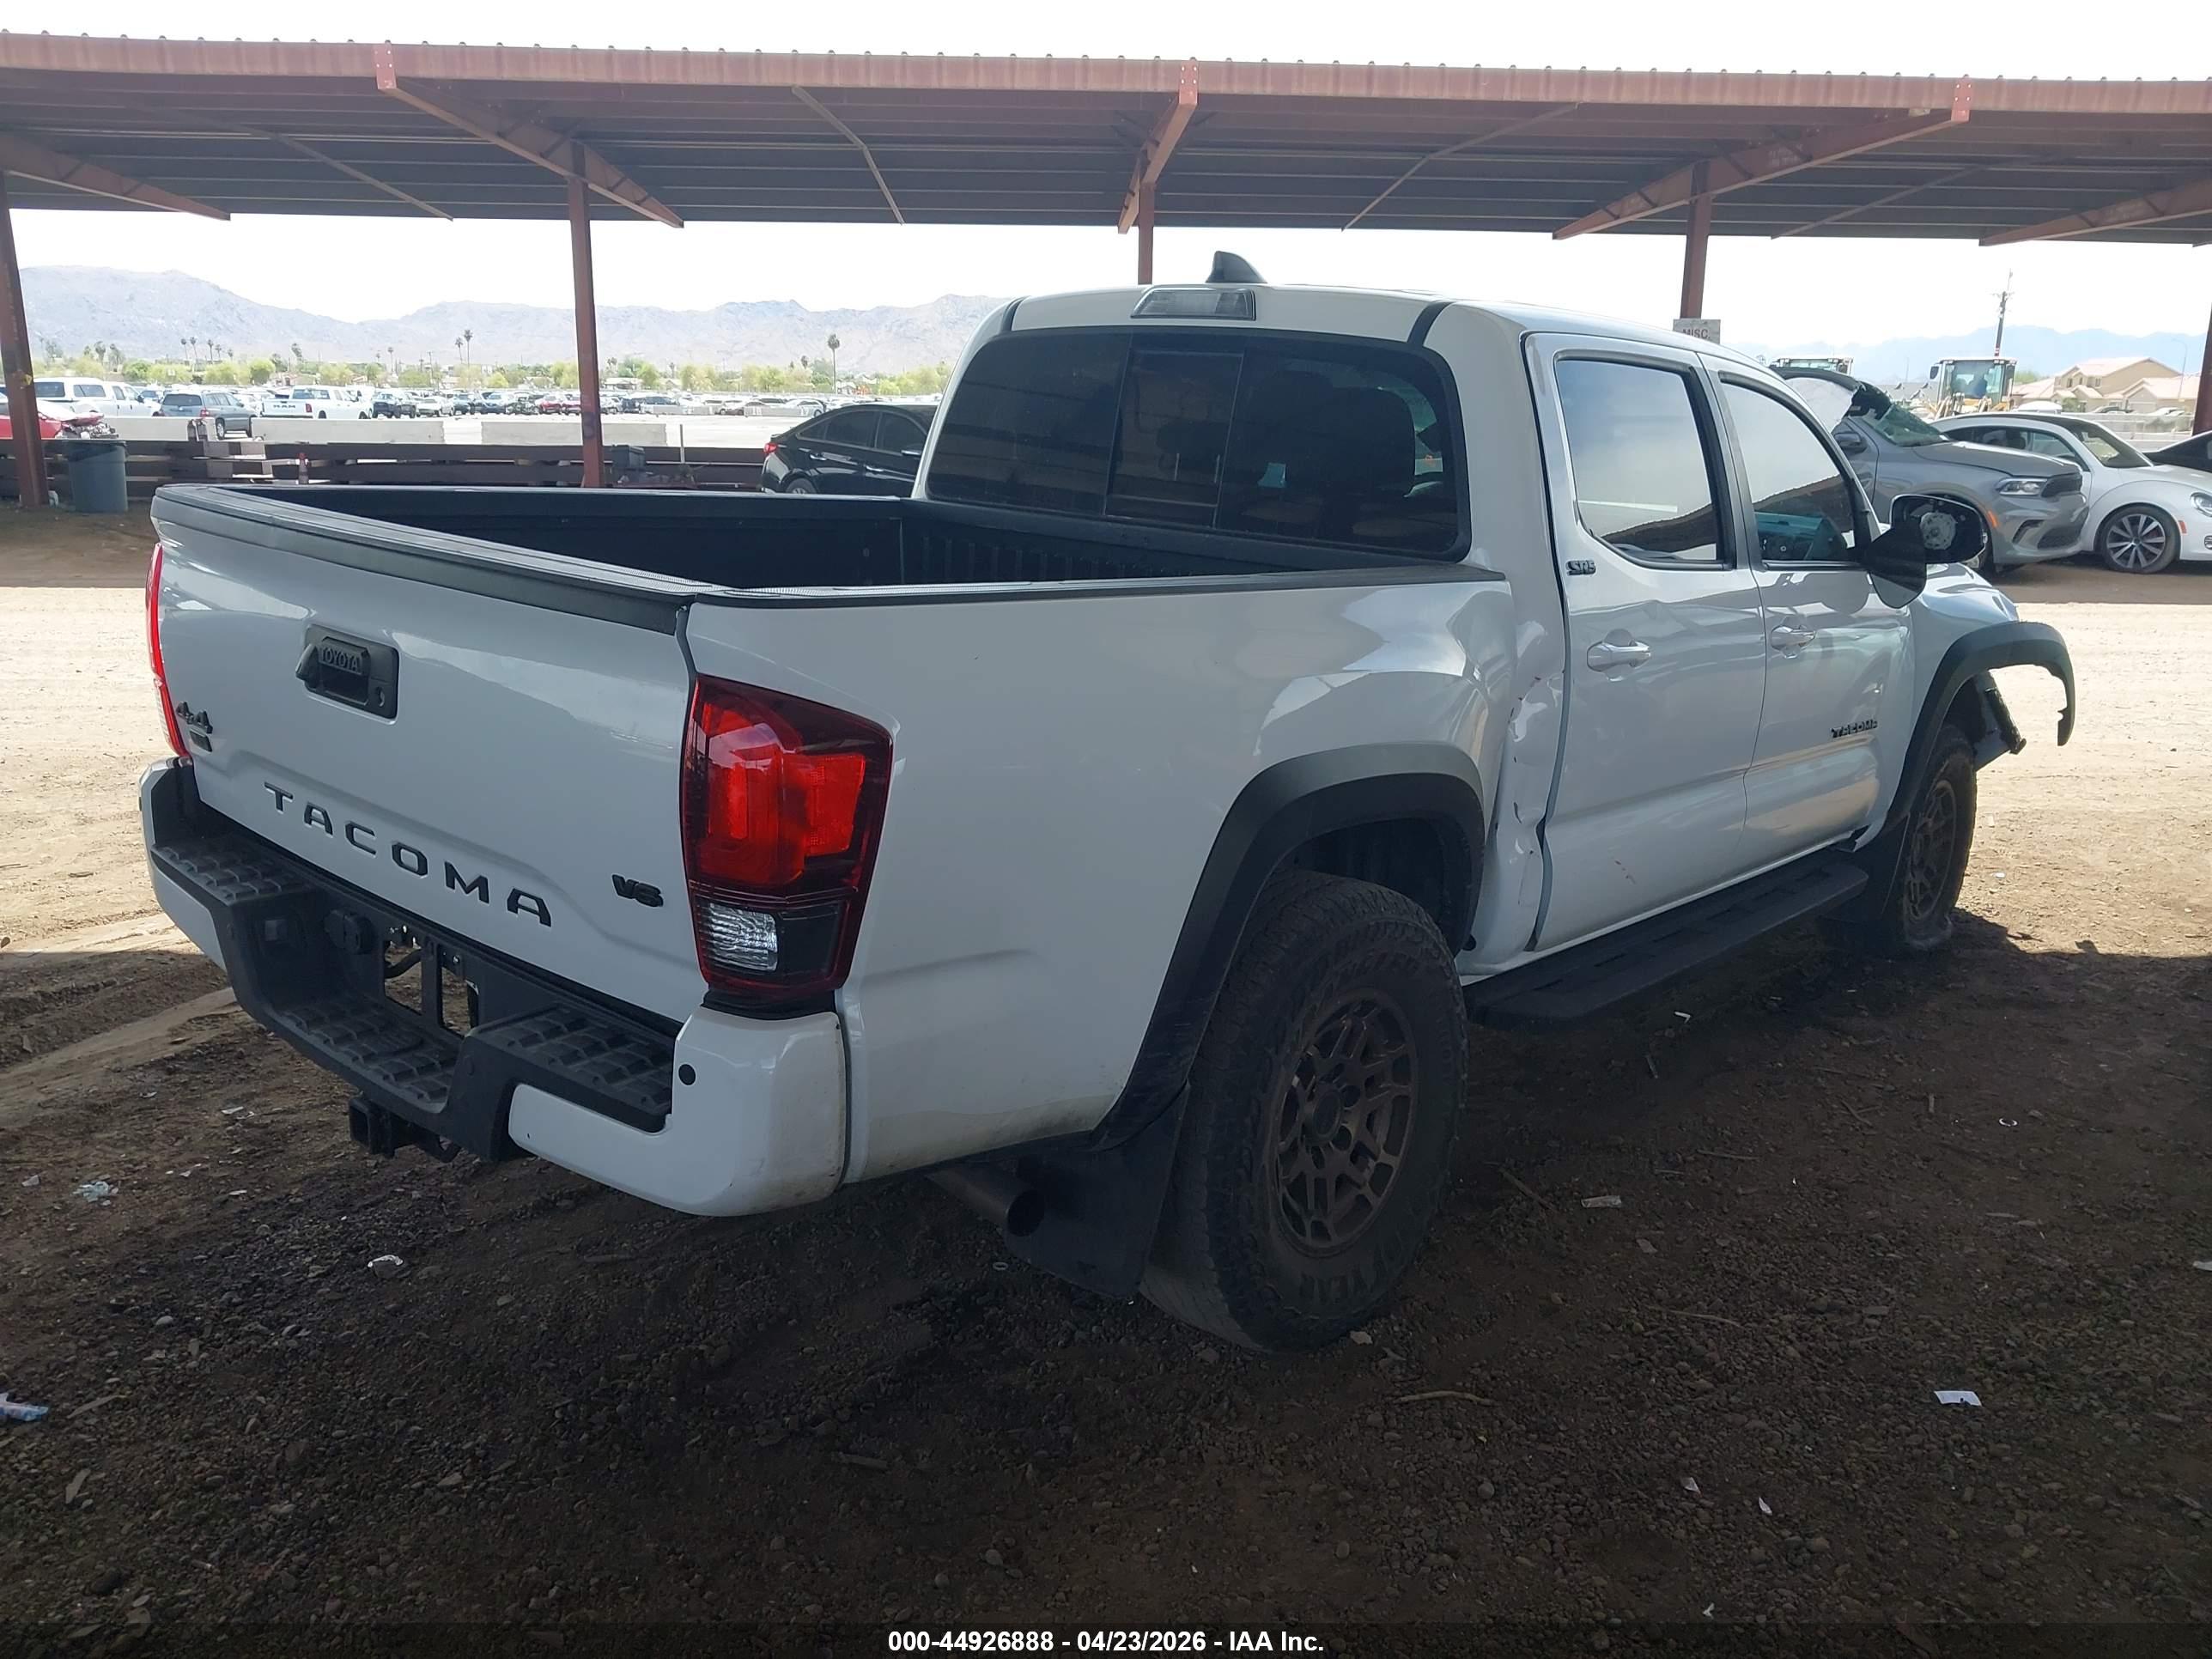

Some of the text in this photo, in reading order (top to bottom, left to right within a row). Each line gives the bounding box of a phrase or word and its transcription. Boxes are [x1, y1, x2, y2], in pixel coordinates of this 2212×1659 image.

[321, 647, 360, 672] TOYOTA
[264, 781, 552, 927] TACOMA
[611, 874, 664, 907] V6
